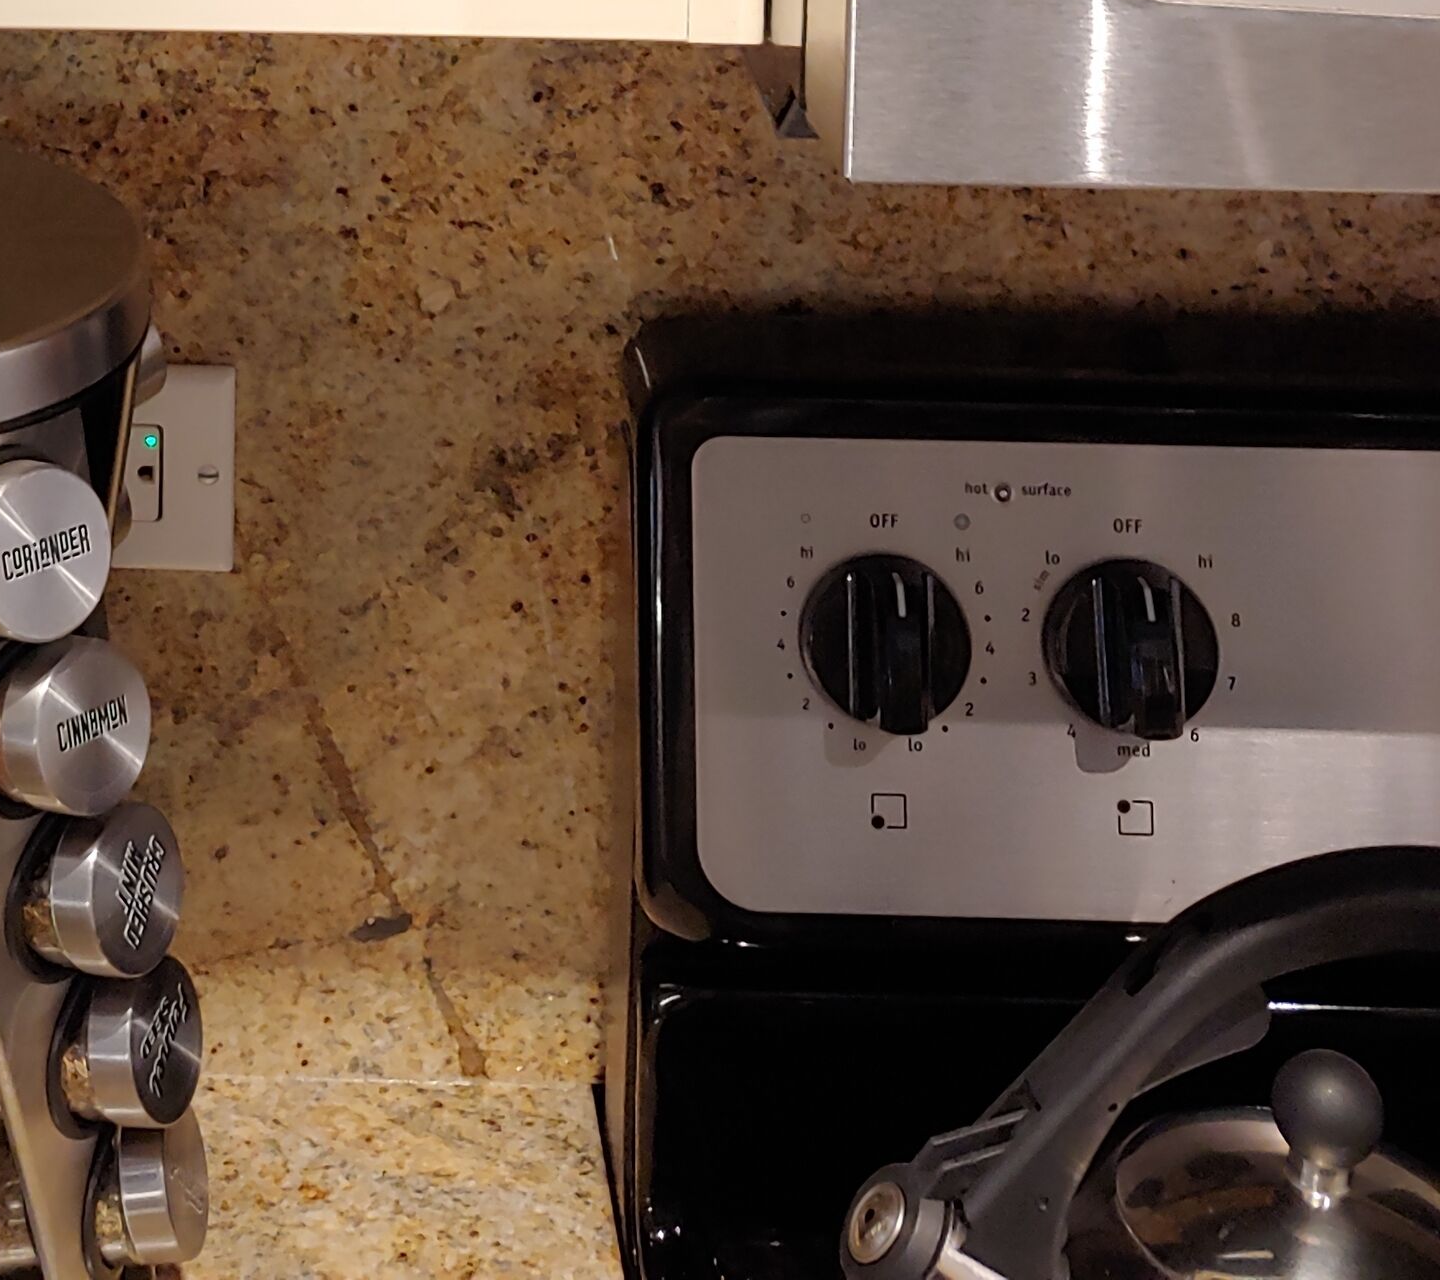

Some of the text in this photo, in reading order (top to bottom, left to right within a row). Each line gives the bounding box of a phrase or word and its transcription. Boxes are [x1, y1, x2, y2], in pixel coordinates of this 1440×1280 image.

[964, 482, 1072, 498] hot surface
[869, 513, 899, 529] OFF
[1112, 518, 1143, 534] OFF
[1, 523, 92, 582] CORiANDER
[800, 545, 814, 559] hi
[955, 547, 971, 562] hi
[1045, 550, 1060, 566] lo
[1197, 553, 1214, 568] hi
[786, 575, 795, 589] 6
[975, 580, 985, 595] 6
[1021, 608, 1031, 622] 2
[1231, 613, 1241, 628] 8
[776, 639, 786, 651] 4
[985, 641, 995, 655] 4
[1028, 672, 1037, 686] 3
[1227, 676, 1236, 690] 7
[801, 697, 810, 711] 2
[964, 702, 974, 717] 2
[56, 692, 129, 754] CINNAMON
[1067, 724, 1077, 738] 4
[1190, 728, 1200, 743] 6
[852, 738, 867, 751] lo
[907, 738, 923, 753] lo
[1116, 742, 1151, 758] med
[114, 839, 142, 918] MINT
[123, 833, 167, 952] CRUSHED
